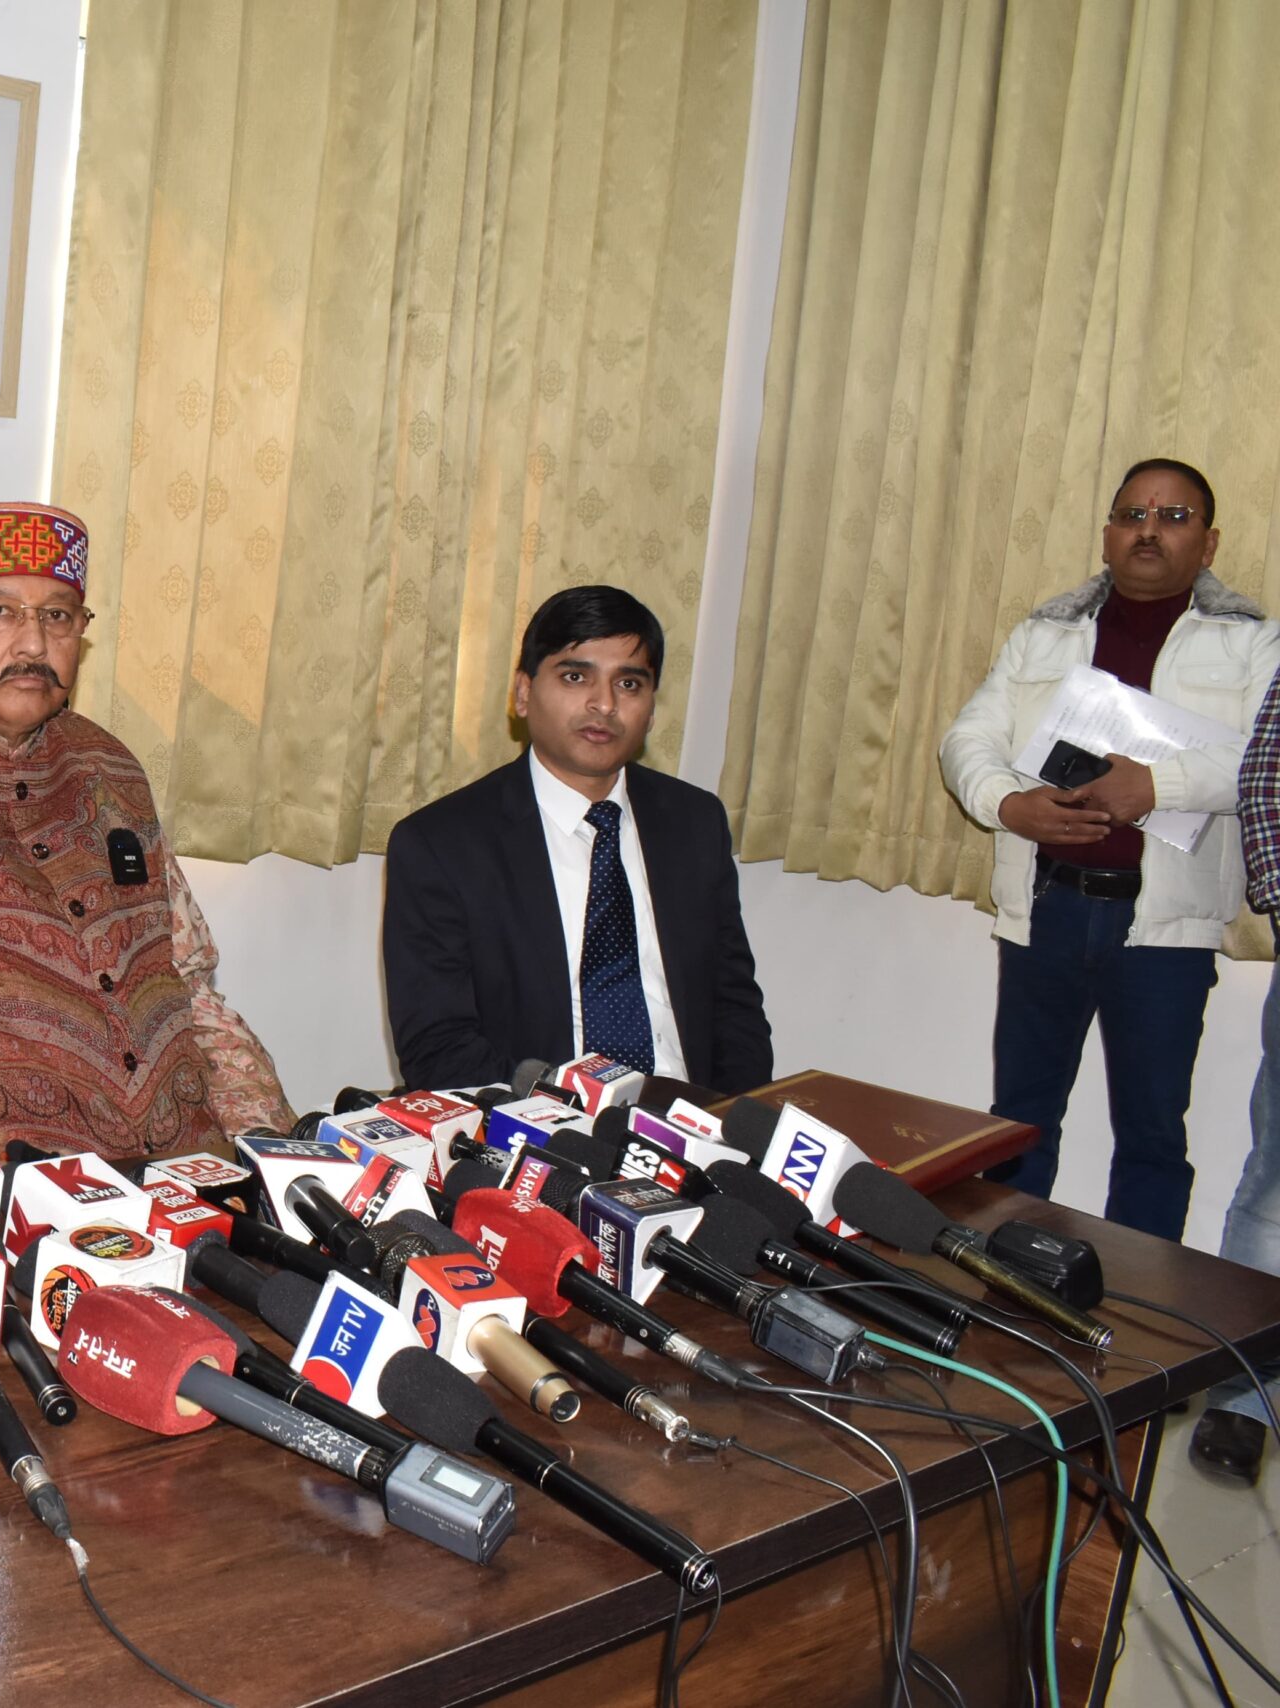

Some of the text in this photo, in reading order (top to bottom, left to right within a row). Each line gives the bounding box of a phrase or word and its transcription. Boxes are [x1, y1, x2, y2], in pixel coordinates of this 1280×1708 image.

[32, 1157, 118, 1196] K
[166, 1159, 224, 1177] DD
[193, 1168, 238, 1183] NEWS
[386, 1169, 403, 1191] Live
[515, 1162, 544, 1200] SHYA
[72, 1187, 122, 1202] NEWS
[330, 1300, 367, 1356] जन TV
